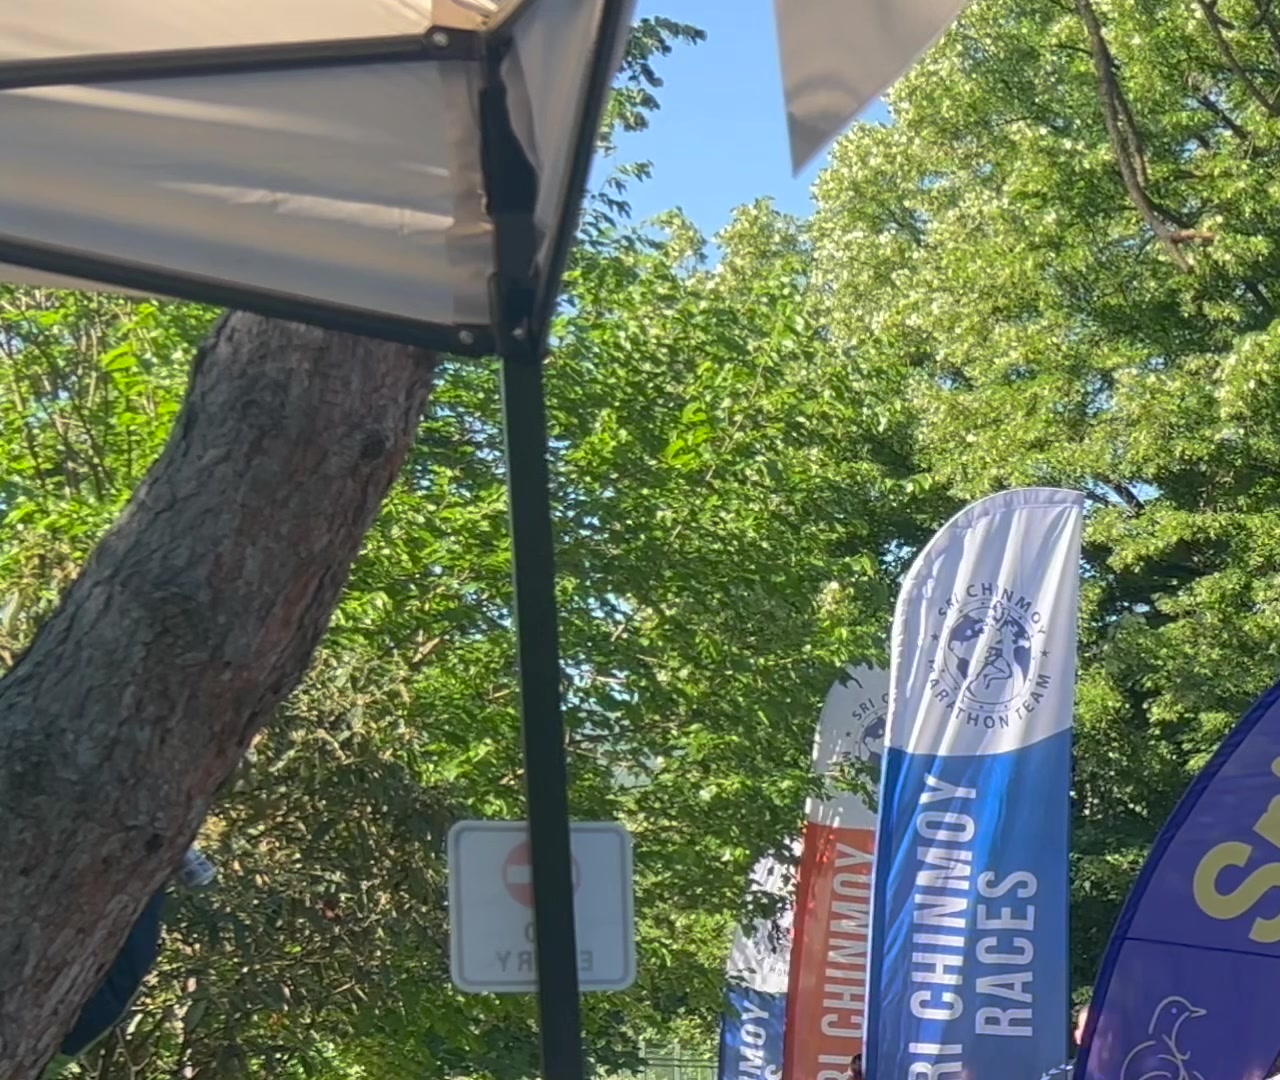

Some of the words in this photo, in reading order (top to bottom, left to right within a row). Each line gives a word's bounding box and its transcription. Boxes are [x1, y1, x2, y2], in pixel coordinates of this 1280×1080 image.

[1015, 674, 1052, 721] TEAM
[820, 842, 876, 1037] CHINMOY
[910, 773, 978, 1020] CHINMOY
[975, 870, 1038, 1037] RACES
